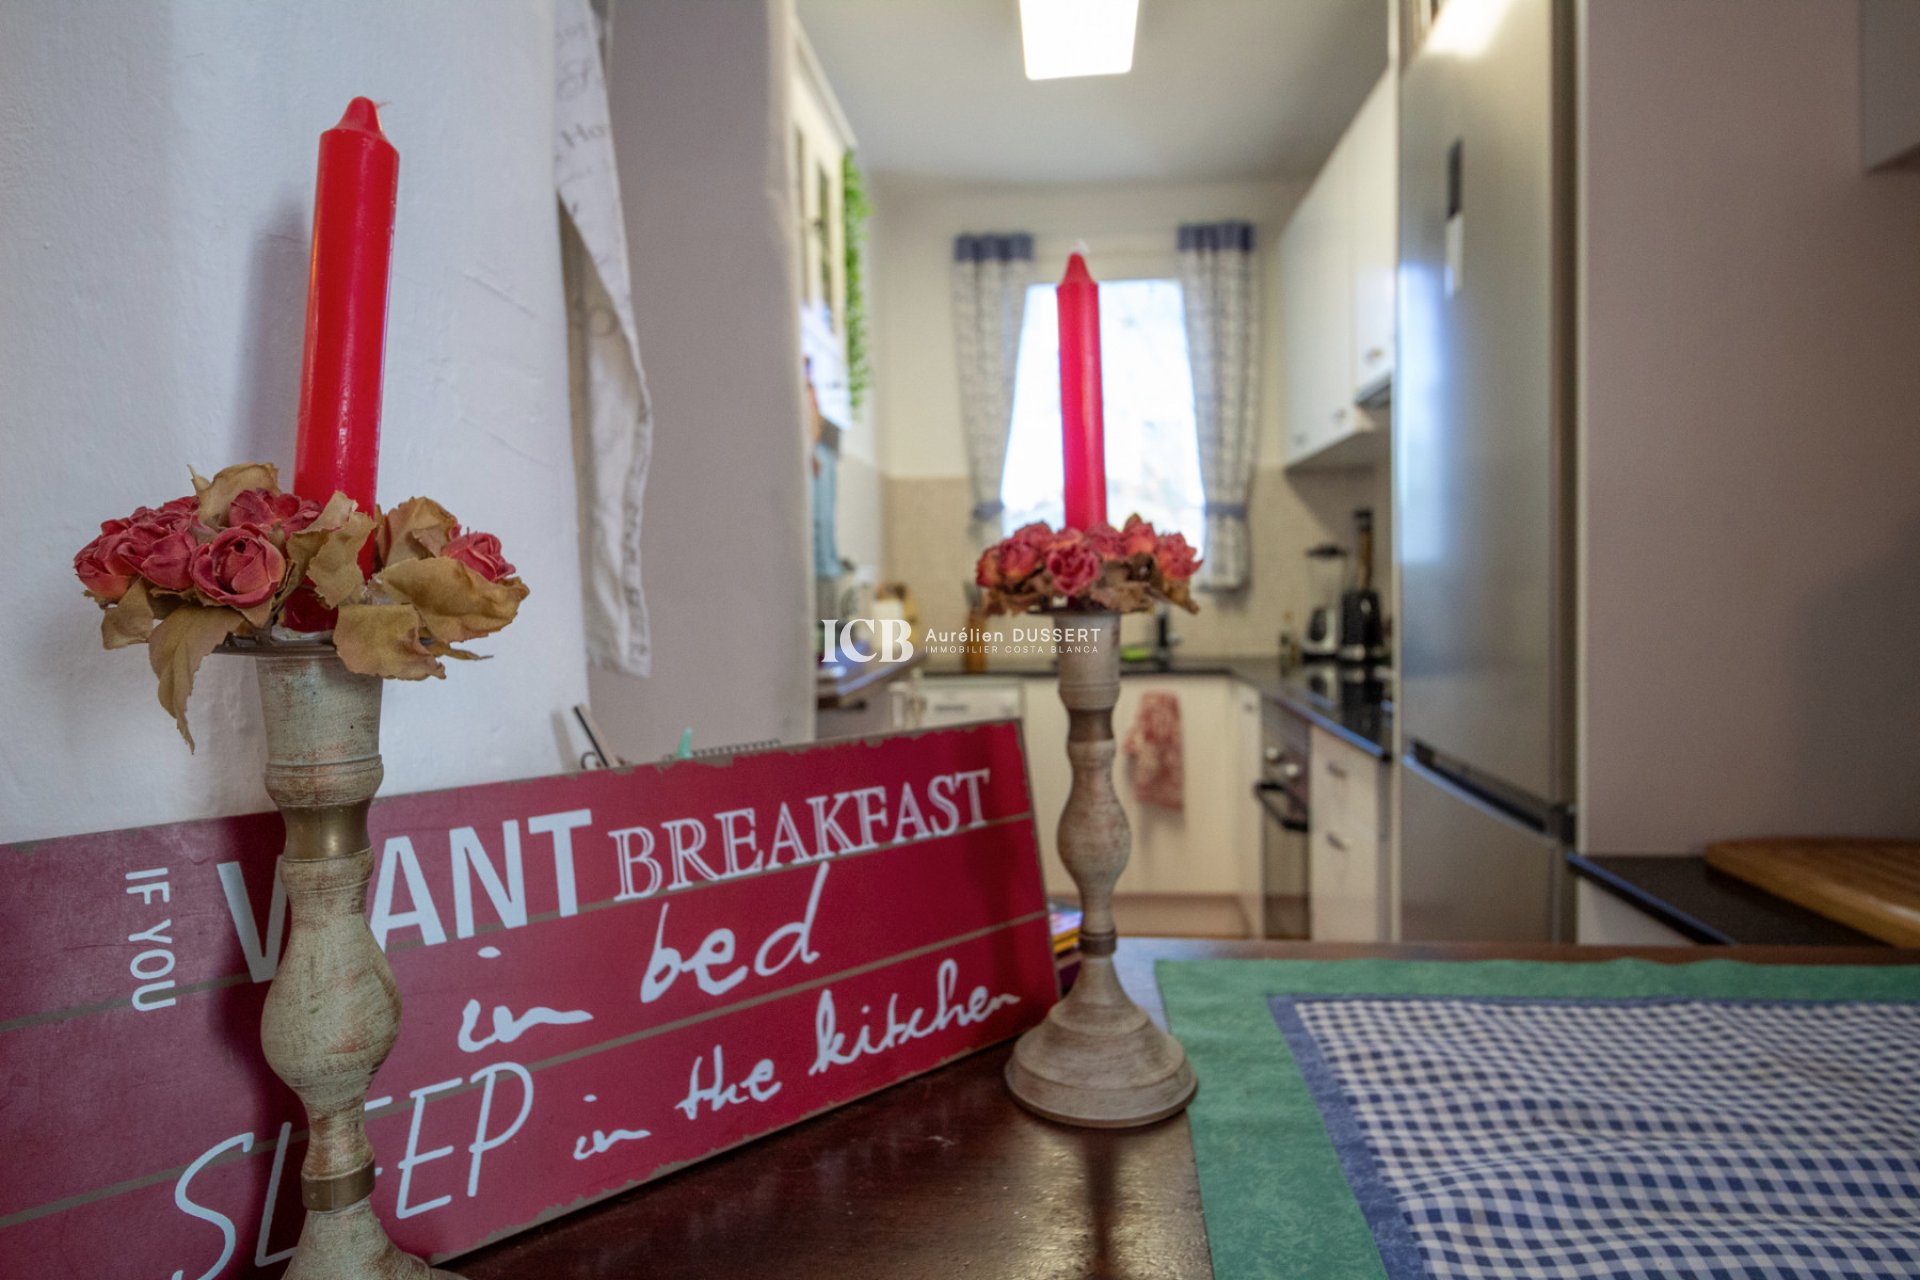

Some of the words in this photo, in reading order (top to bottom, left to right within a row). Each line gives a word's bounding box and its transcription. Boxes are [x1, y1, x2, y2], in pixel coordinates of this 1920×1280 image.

[126, 867, 170, 905] IF
[608, 768, 990, 902] BREAKFAST
[128, 919, 176, 1012] YOU
[457, 946, 594, 1053] in
[641, 861, 829, 1003] bed
[171, 1062, 534, 1280] SLEP
[573, 1094, 651, 1160] in
[675, 1045, 782, 1120] the
[808, 959, 1021, 1076] kitchen
